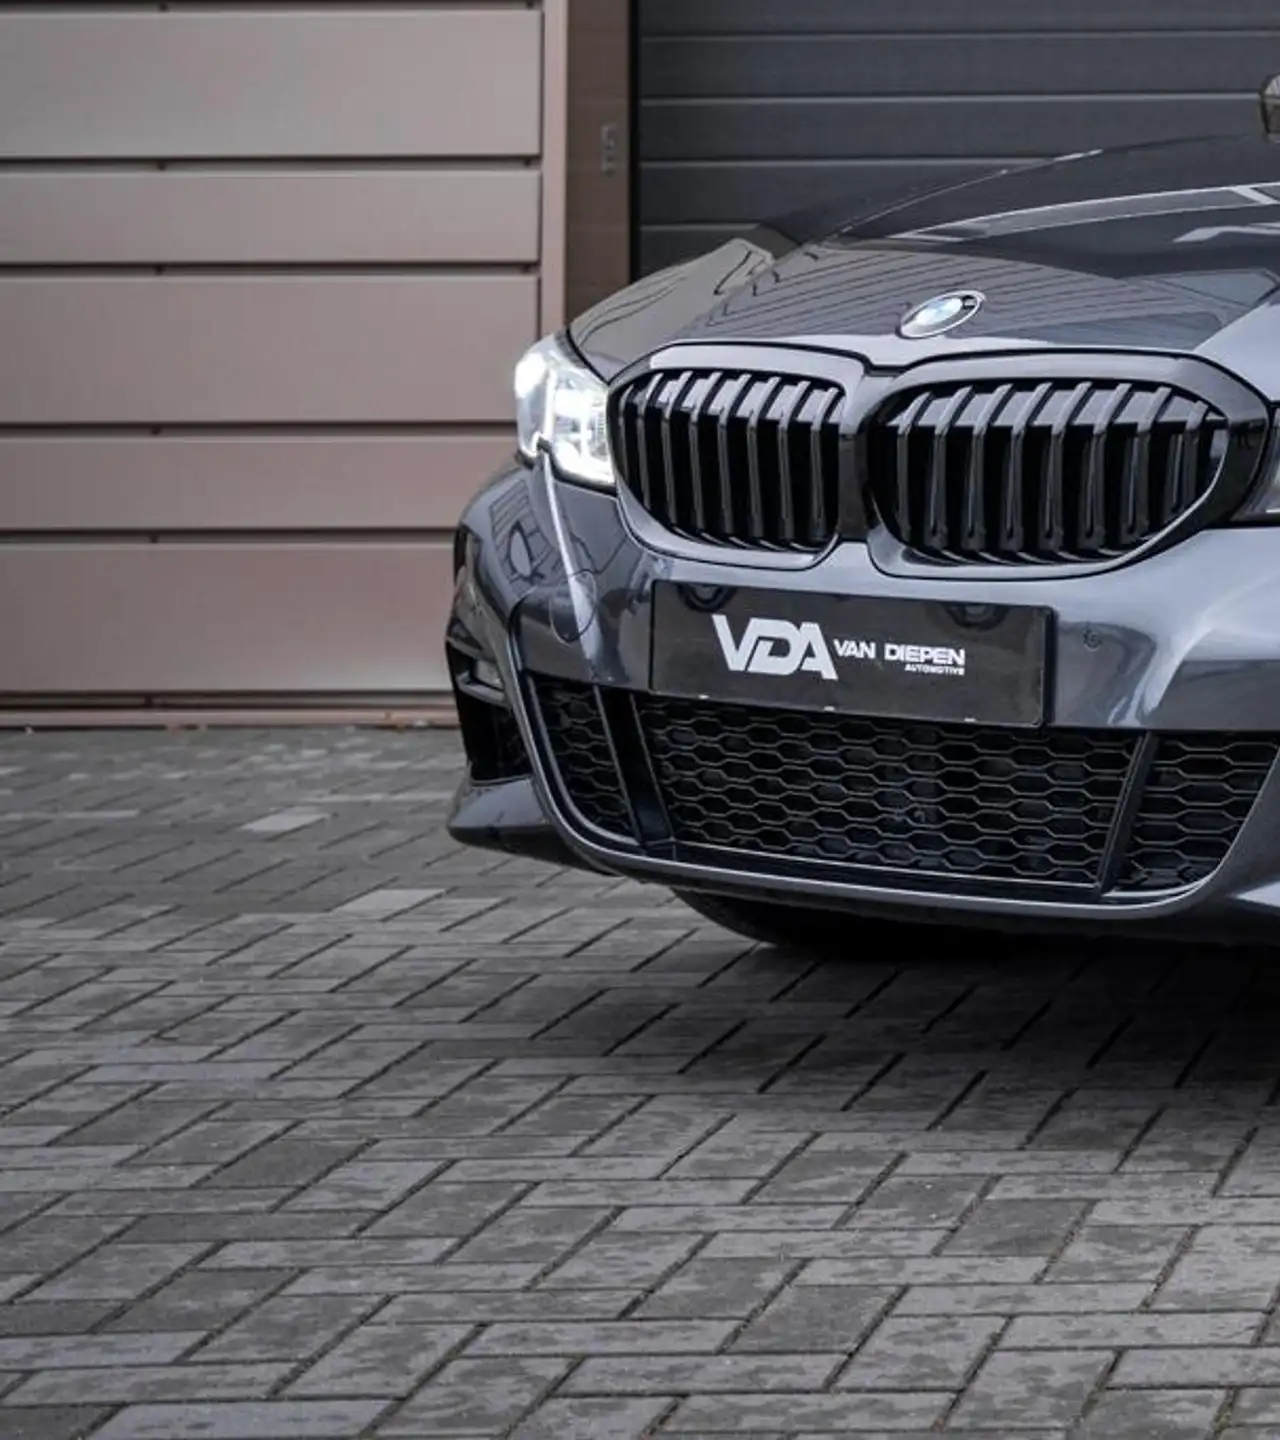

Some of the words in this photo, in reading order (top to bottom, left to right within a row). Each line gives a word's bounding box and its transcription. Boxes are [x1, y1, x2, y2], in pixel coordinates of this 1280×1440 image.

[712, 614, 839, 681] VDA
[833, 638, 876, 660] VAN
[884, 642, 966, 666] DIEPEN
